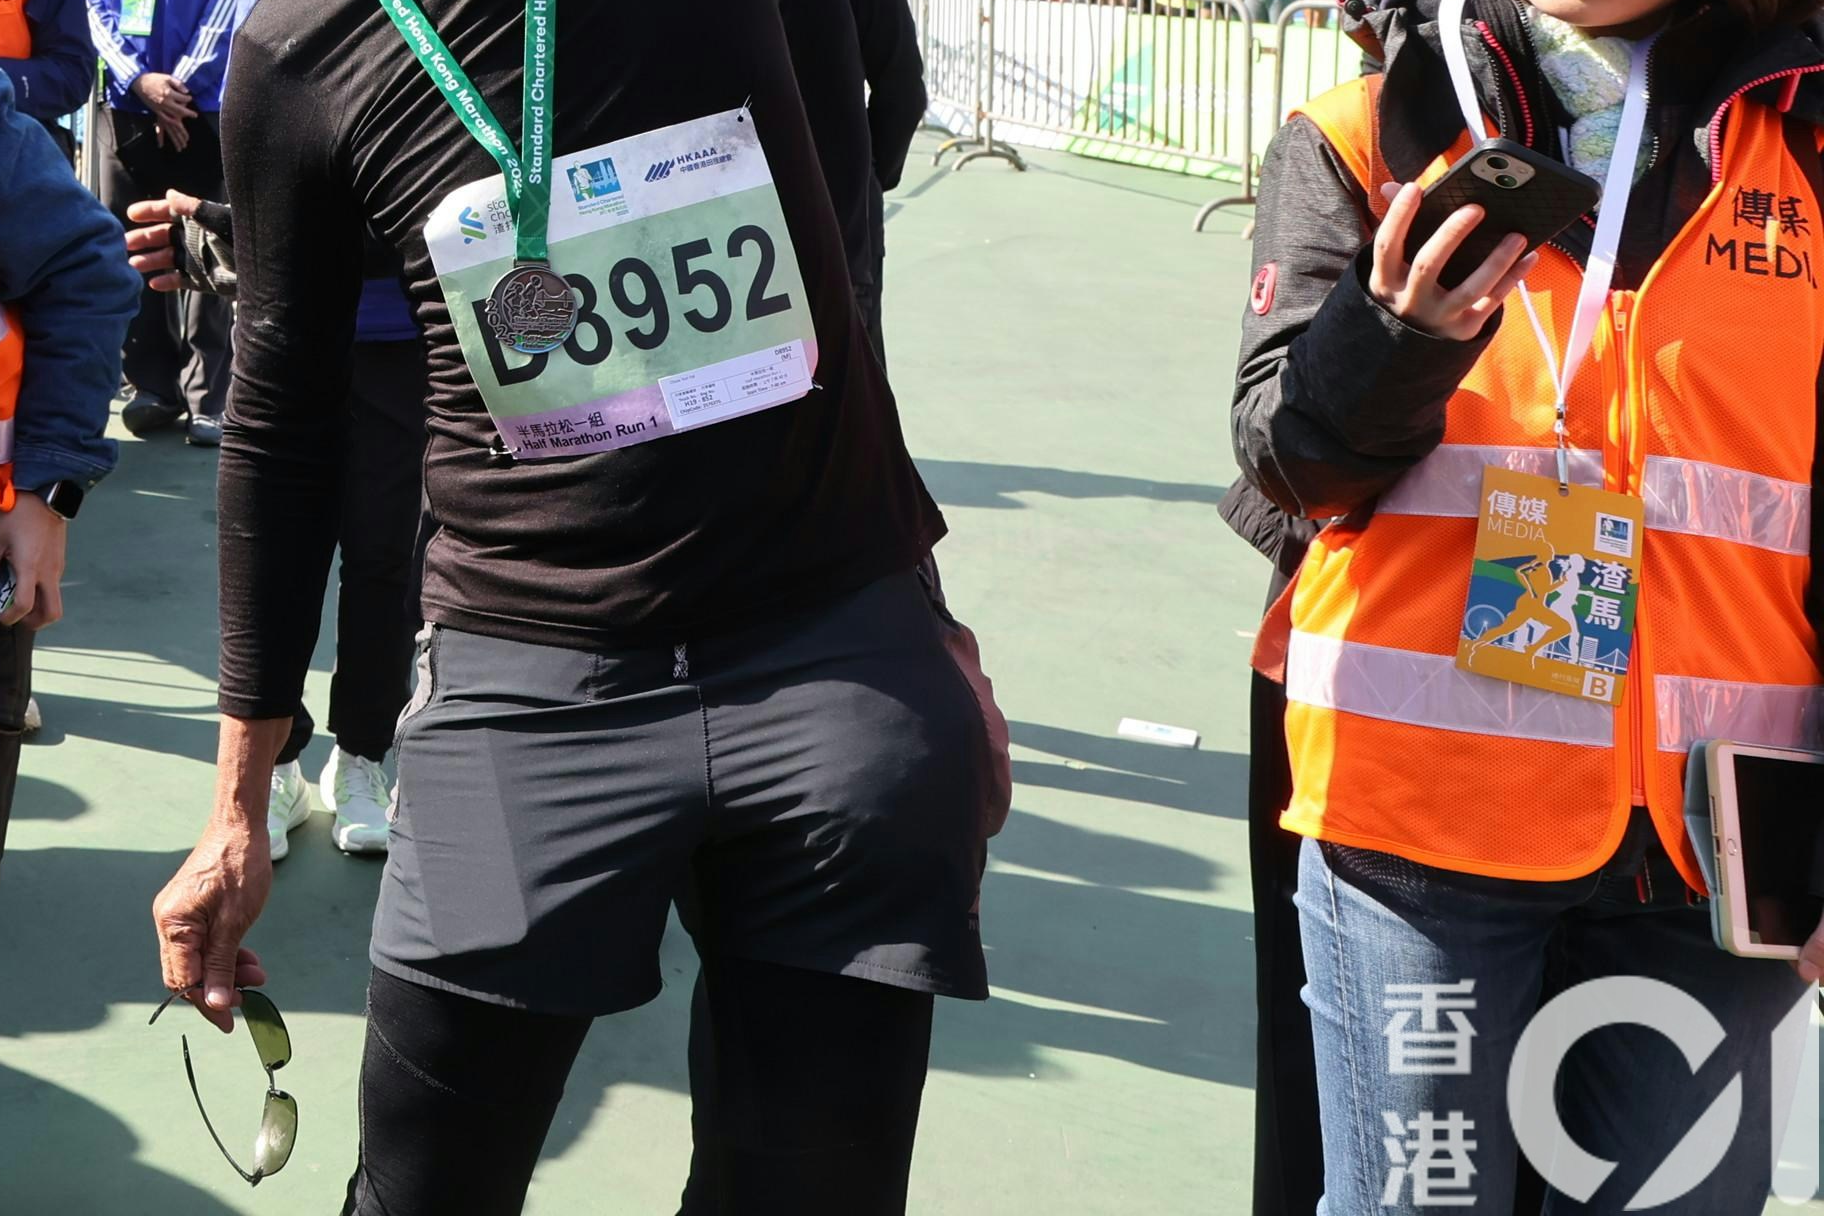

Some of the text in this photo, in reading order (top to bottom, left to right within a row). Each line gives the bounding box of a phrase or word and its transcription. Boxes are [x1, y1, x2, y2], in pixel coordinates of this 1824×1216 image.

[531, 16, 547, 102] Chartered
[405, 10, 434, 54] Hong
[431, 52, 460, 91] Kong
[456, 89, 509, 156] Marathon
[529, 106, 545, 184] Standard
[677, 147, 717, 165] HKAAA
[493, 221, 514, 235] 渣打
[1706, 233, 1817, 290] MEDI
[516, 411, 605, 439] 半馬拉松一組
[524, 415, 659, 452] Half Marathon Run 1
[1487, 489, 1549, 526] 傳媒
[1487, 516, 1547, 542] MEDIA
[1585, 558, 1628, 631] 渣馬
[1589, 676, 1607, 698] B
